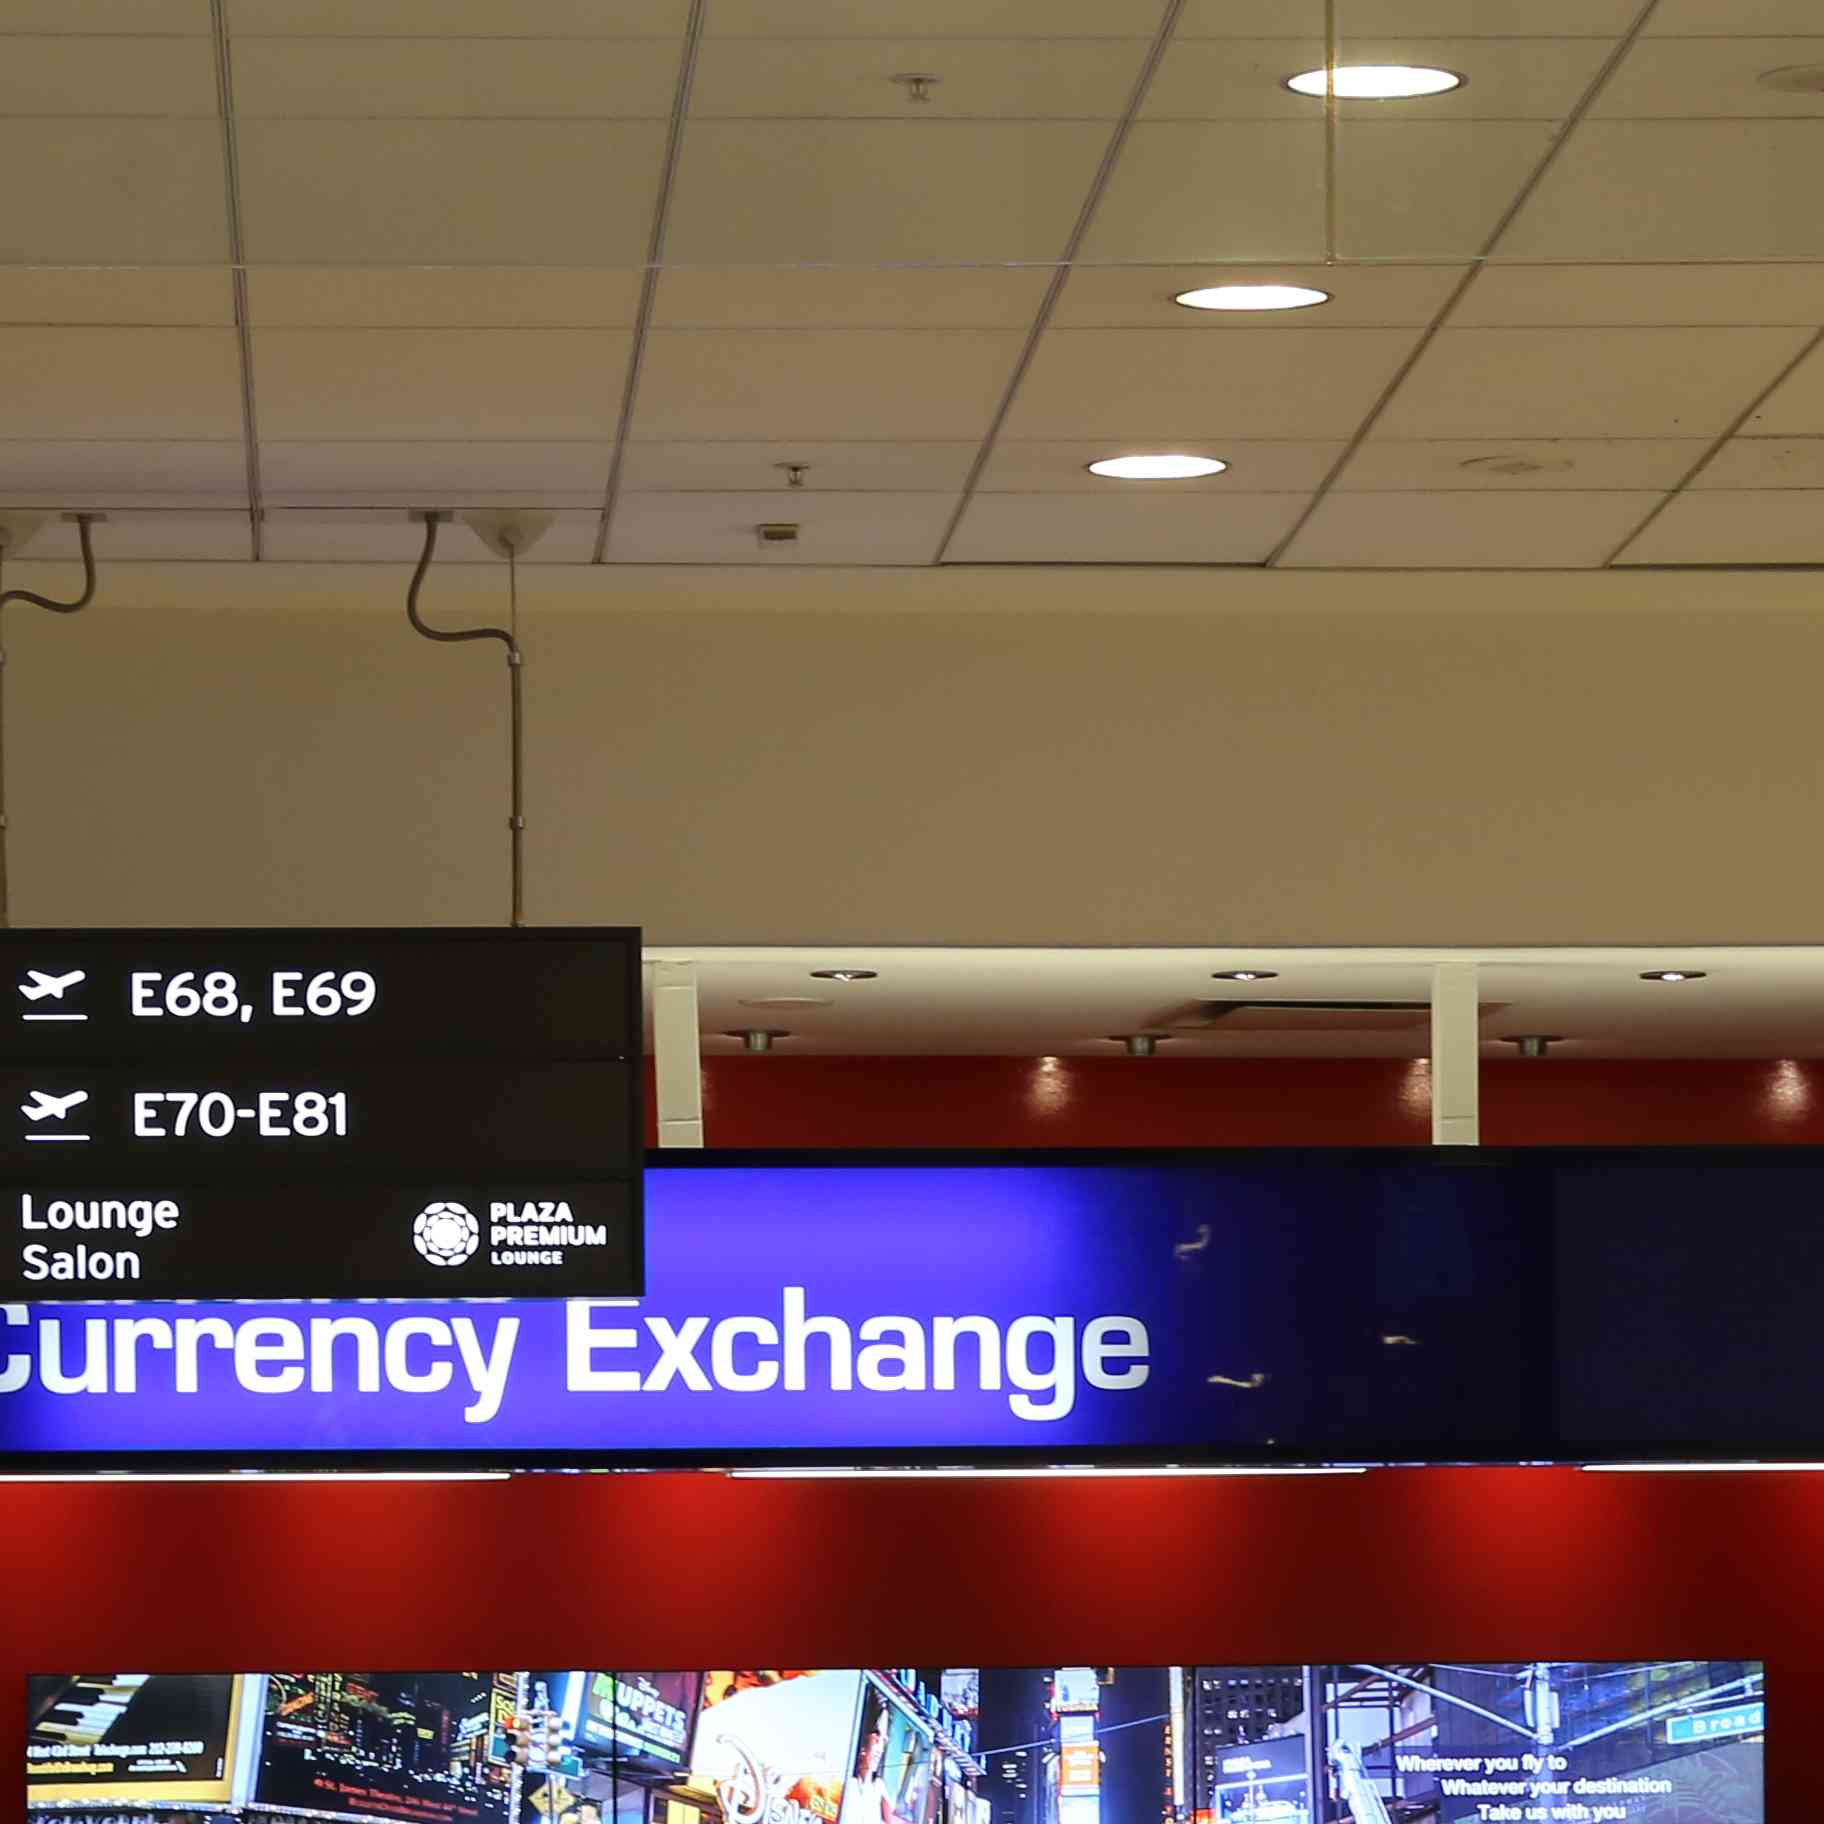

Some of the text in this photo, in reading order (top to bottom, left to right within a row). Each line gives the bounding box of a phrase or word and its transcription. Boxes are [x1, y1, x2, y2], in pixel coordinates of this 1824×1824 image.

[130, 971, 375, 1023] E68, E69
[133, 1092, 348, 1138] E70-E81
[22, 1194, 180, 1238] Lounge
[490, 1202, 573, 1223] PLAZA
[490, 1225, 607, 1247] PREMIUM
[22, 1244, 140, 1281] Salon
[490, 1251, 564, 1266] LOUNGE
[566, 1287, 1150, 1422] Exchange
[1396, 1753, 1567, 1775] Wherever you fly to
[1441, 1776, 1672, 1798] Whatever your destination
[1477, 1803, 1626, 1823] Take us with you
